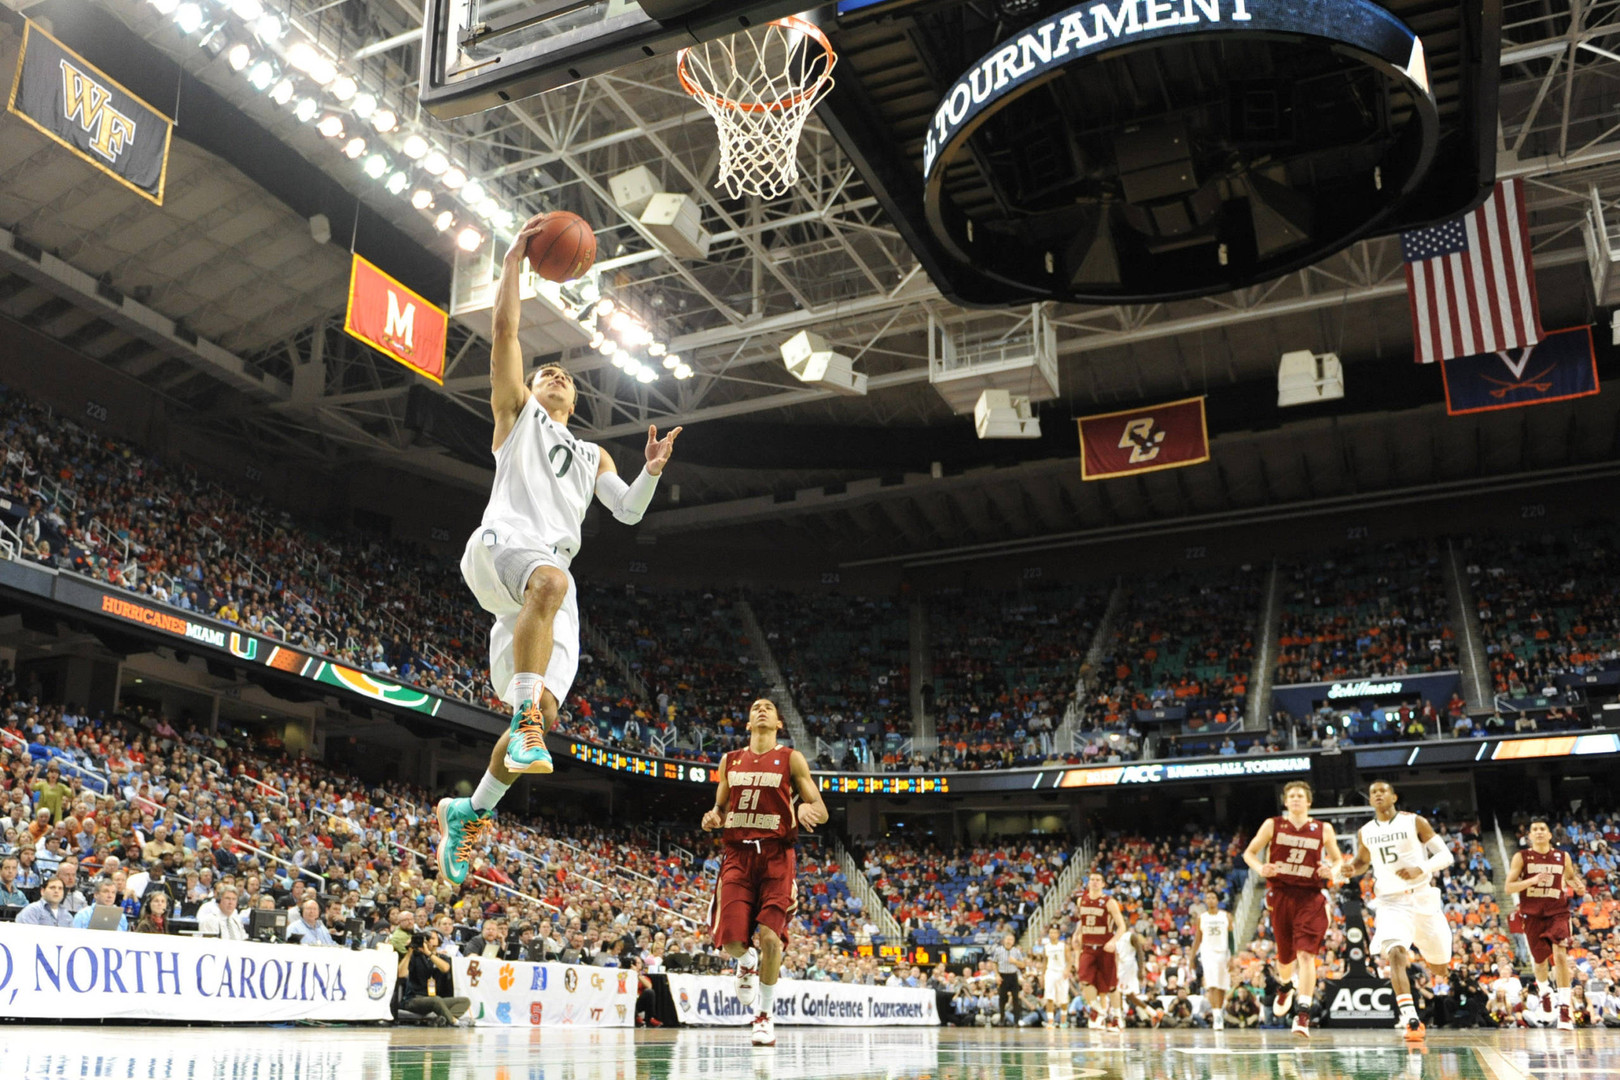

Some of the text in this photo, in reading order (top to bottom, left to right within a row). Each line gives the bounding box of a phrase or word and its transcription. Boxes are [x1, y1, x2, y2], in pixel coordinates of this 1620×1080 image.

[60, 59, 136, 162] WF
[384, 289, 416, 349] M
[629, 560, 648, 573] 225
[102, 595, 187, 636] HURRICANES
[185, 622, 225, 647] MIAMI
[727, 771, 783, 788] BOSTON
[1121, 765, 1163, 784] ACC
[1167, 761, 1245, 779] BASKETBALL
[738, 789, 761, 810] 21
[724, 812, 782, 829] COLLEGE
[1366, 831, 1408, 845] miami
[1379, 845, 1399, 865] 15
[34, 943, 182, 995] NORTH
[195, 953, 347, 1001] CAROLINA
[697, 989, 754, 1016] Atlan
[802, 992, 864, 1018] Conference
[868, 996, 924, 1018] Tournament
[1329, 987, 1393, 1011] ACC
